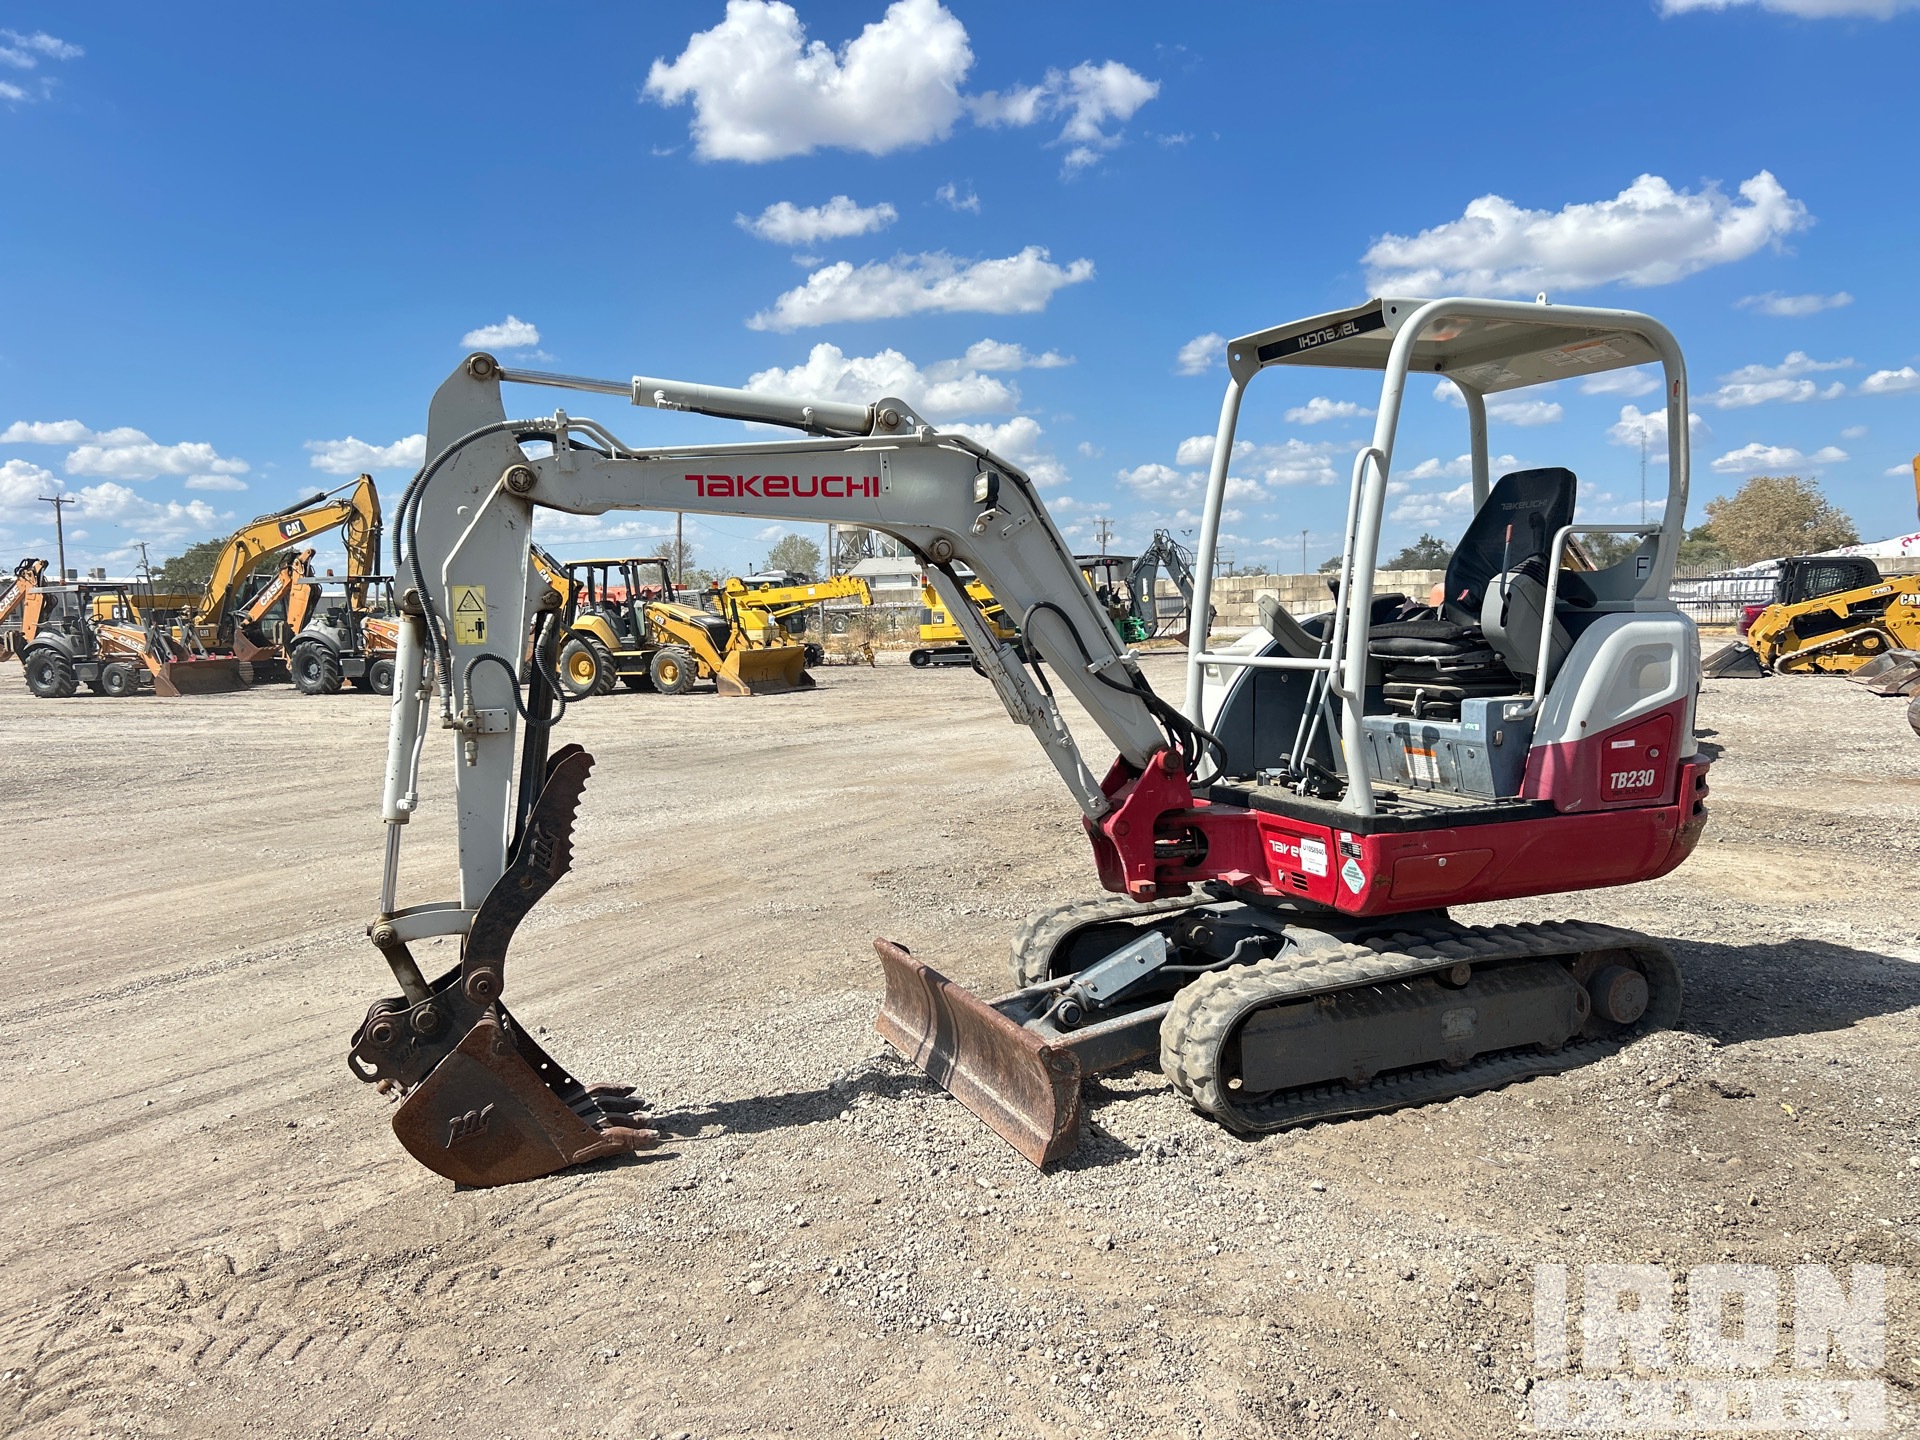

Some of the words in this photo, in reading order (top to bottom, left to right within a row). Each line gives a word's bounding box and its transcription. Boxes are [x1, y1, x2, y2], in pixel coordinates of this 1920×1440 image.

[285, 520, 301, 537] CAT
[1636, 556, 1649, 578] F
[539, 569, 553, 584] CAT
[0, 585, 20, 613] CASE
[260, 579, 283, 606] CASE
[113, 607, 128, 619] CT
[200, 629, 209, 637] CAT
[119, 635, 145, 652] CASE
[1610, 769, 1655, 790] TB230
